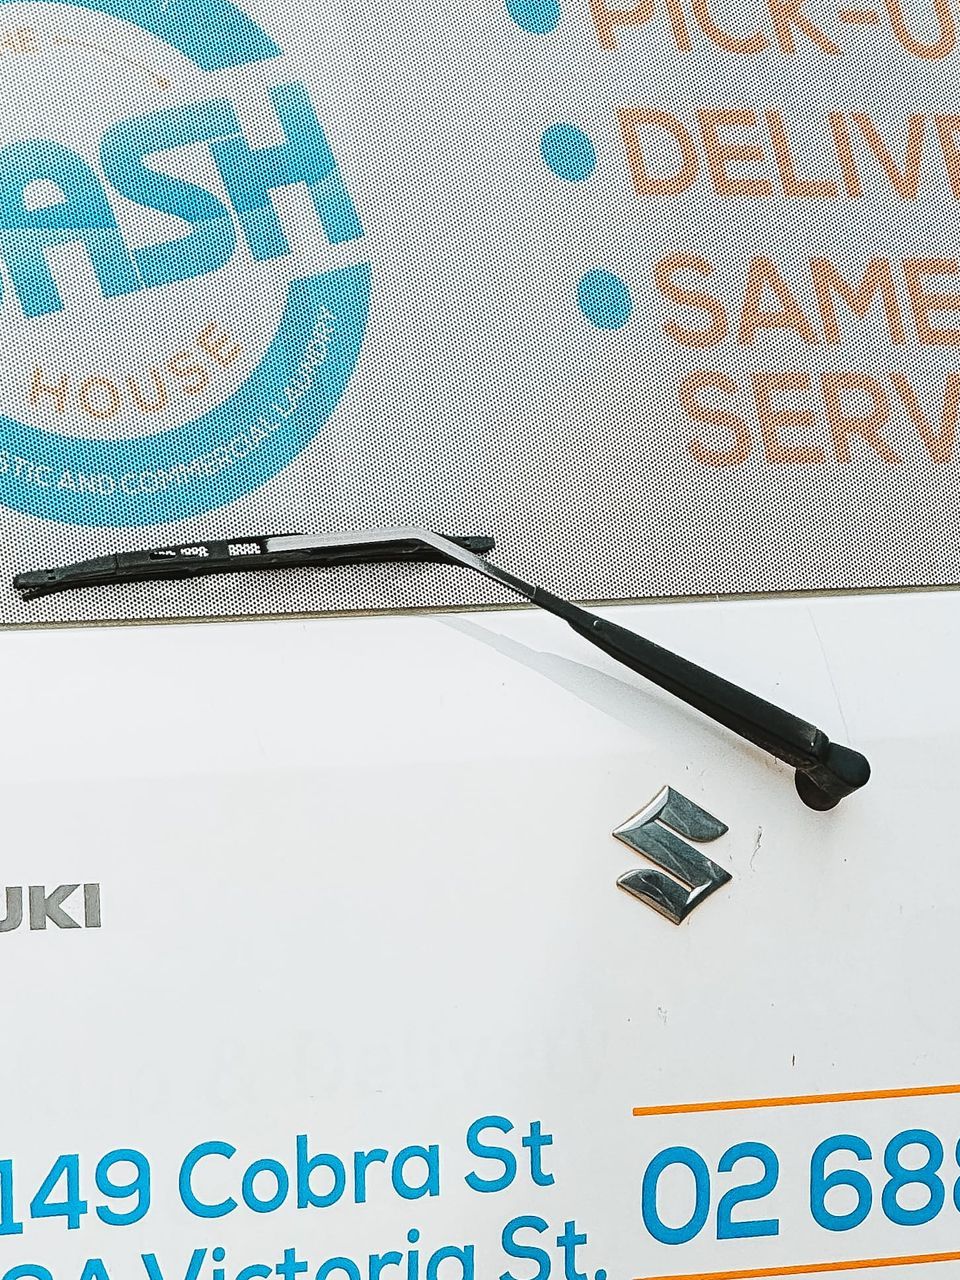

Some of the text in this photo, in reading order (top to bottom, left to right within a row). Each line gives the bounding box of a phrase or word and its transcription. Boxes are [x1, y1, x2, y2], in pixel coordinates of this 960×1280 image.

[0, 80, 366, 318] ASH
[29, 322, 242, 419] HOUSE
[57, 470, 116, 496] AND
[121, 417, 280, 495] COMMERCIAL
[277, 304, 338, 418] LAUNDRY
[0, 1115, 555, 1236] 149 Cobra St
[641, 1142, 780, 1246] 02
[141, 1215, 608, 1280] tria St.
